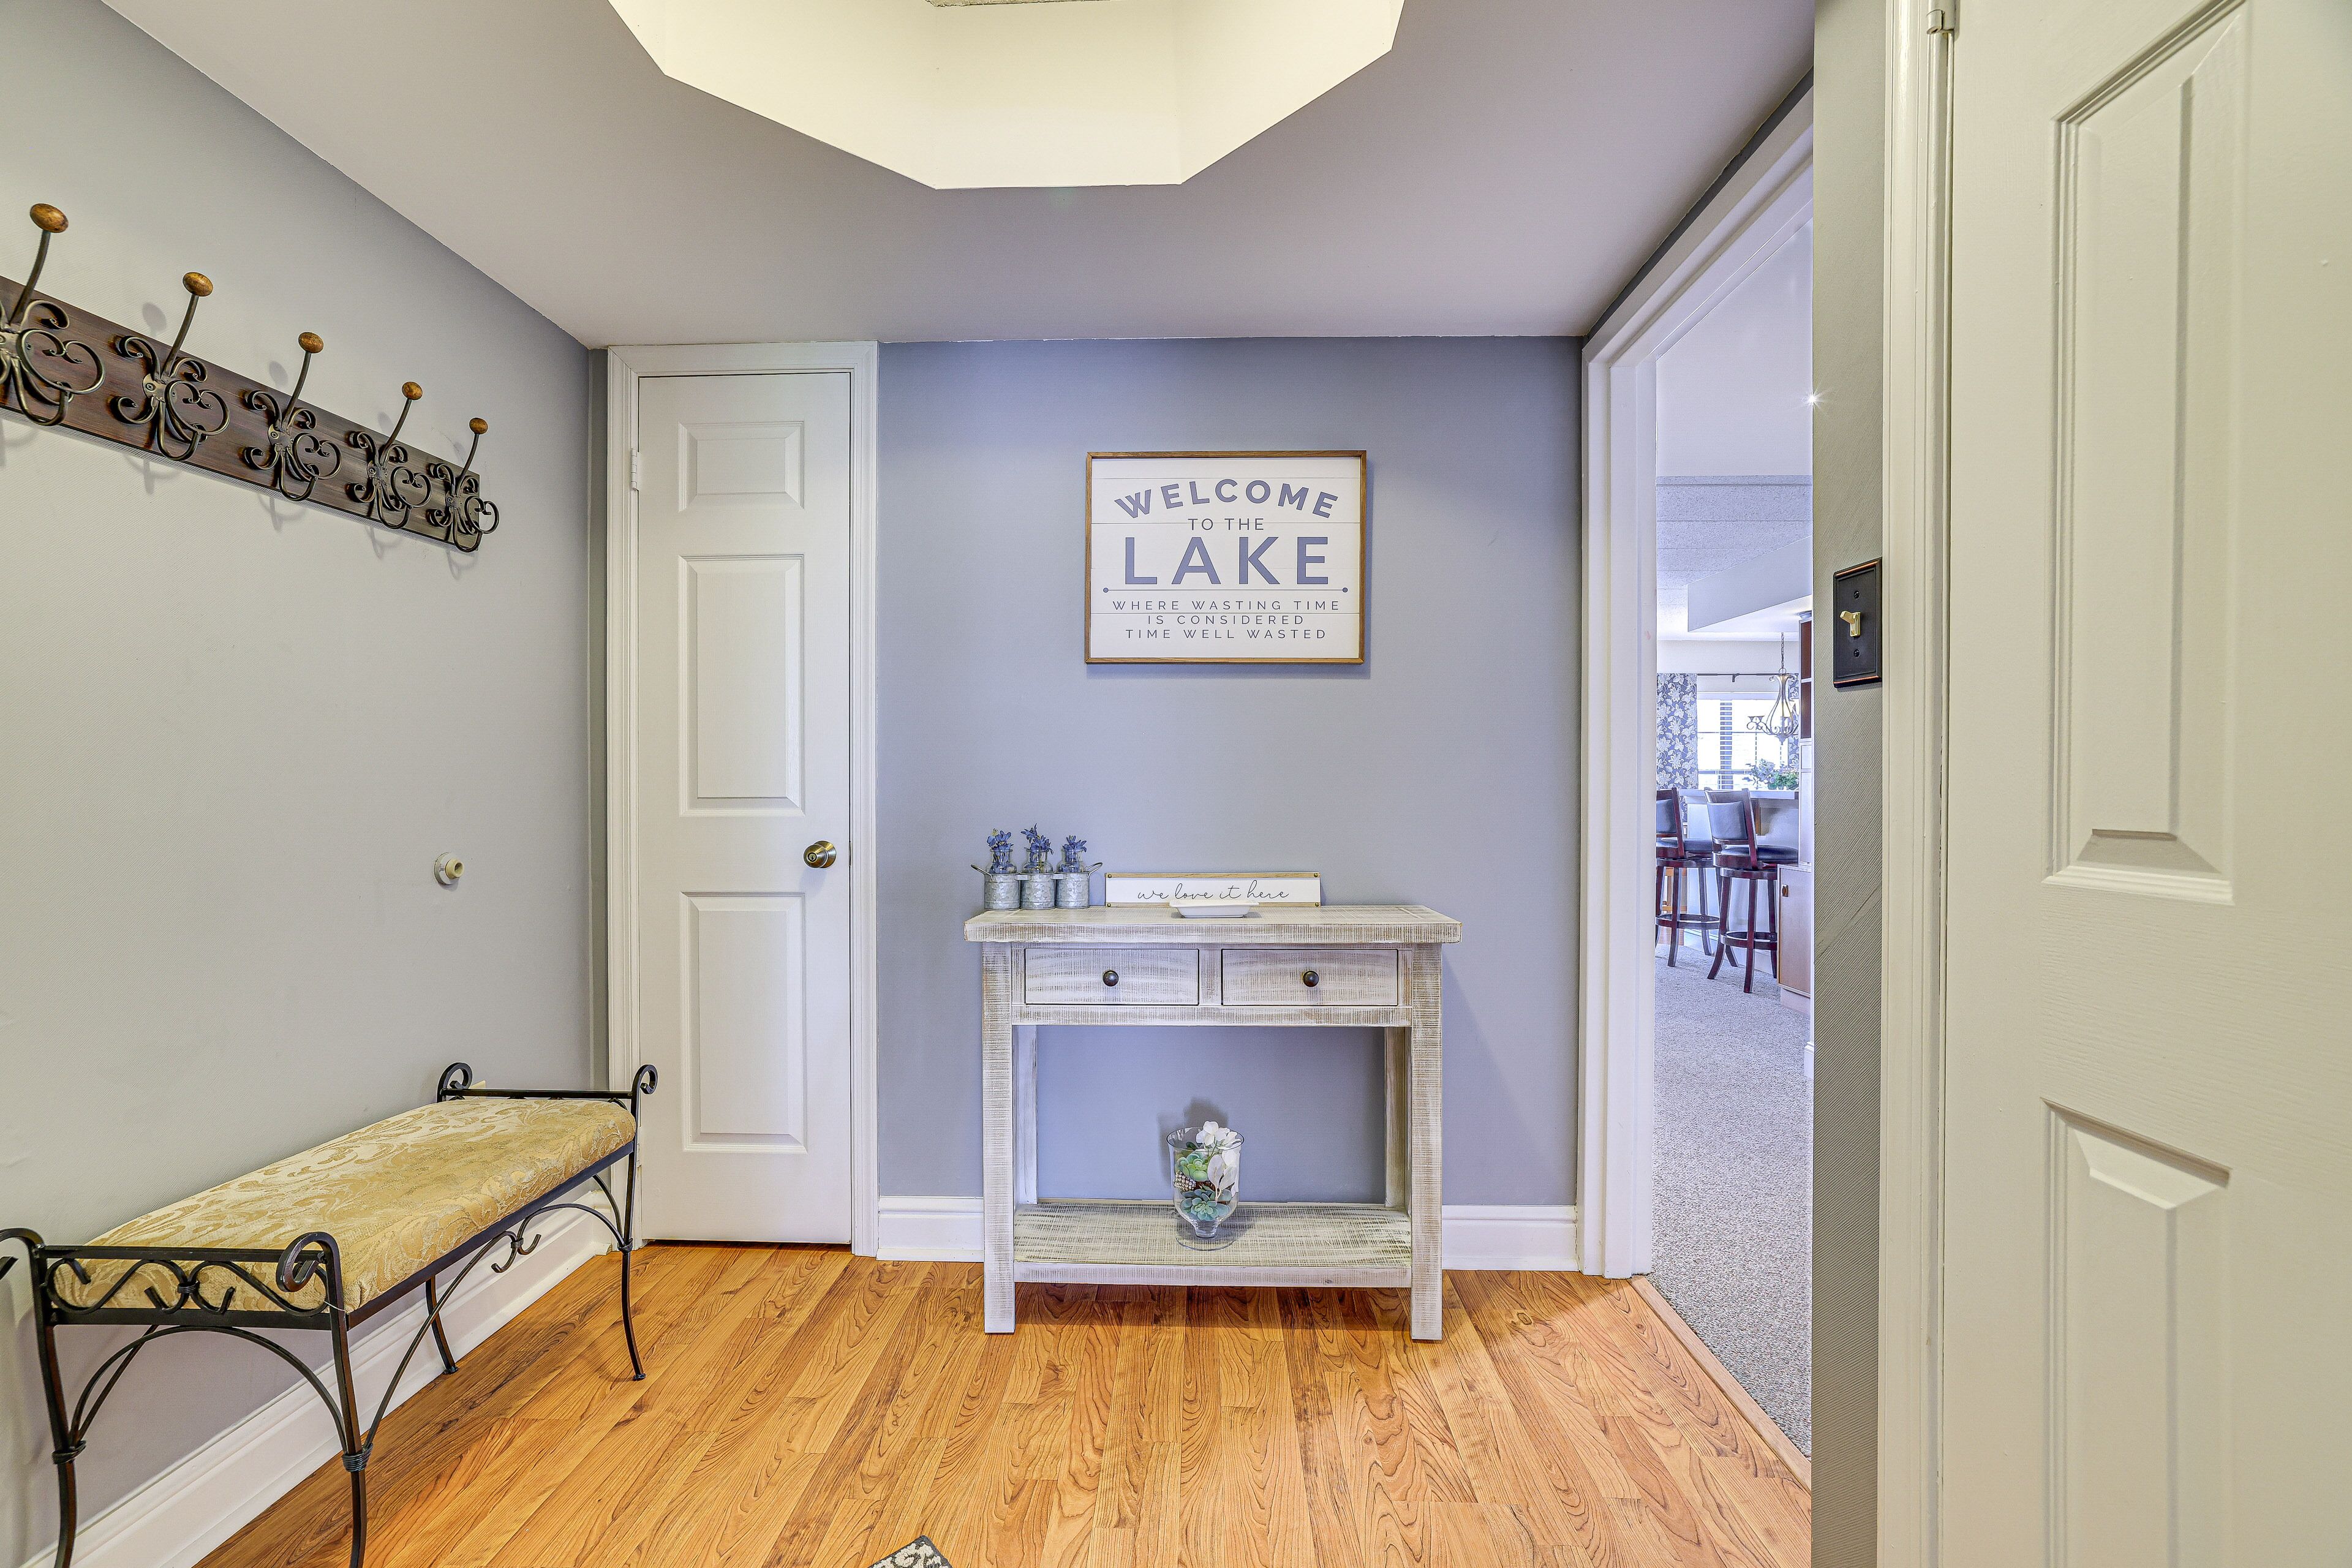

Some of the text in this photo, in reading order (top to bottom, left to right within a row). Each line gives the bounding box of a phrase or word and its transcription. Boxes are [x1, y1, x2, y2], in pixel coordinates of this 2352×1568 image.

[1114, 478, 1338, 518] WELCOME
[1188, 518, 1264, 530] TO THE
[1125, 537, 1329, 584] LAKE
[1112, 600, 1339, 611] WHERE WASTING TIME
[1148, 615, 1304, 625] IS CONSIDERED
[1125, 629, 1325, 639] TIME WELL WASTED
[1137, 880, 1289, 899] we love it here
